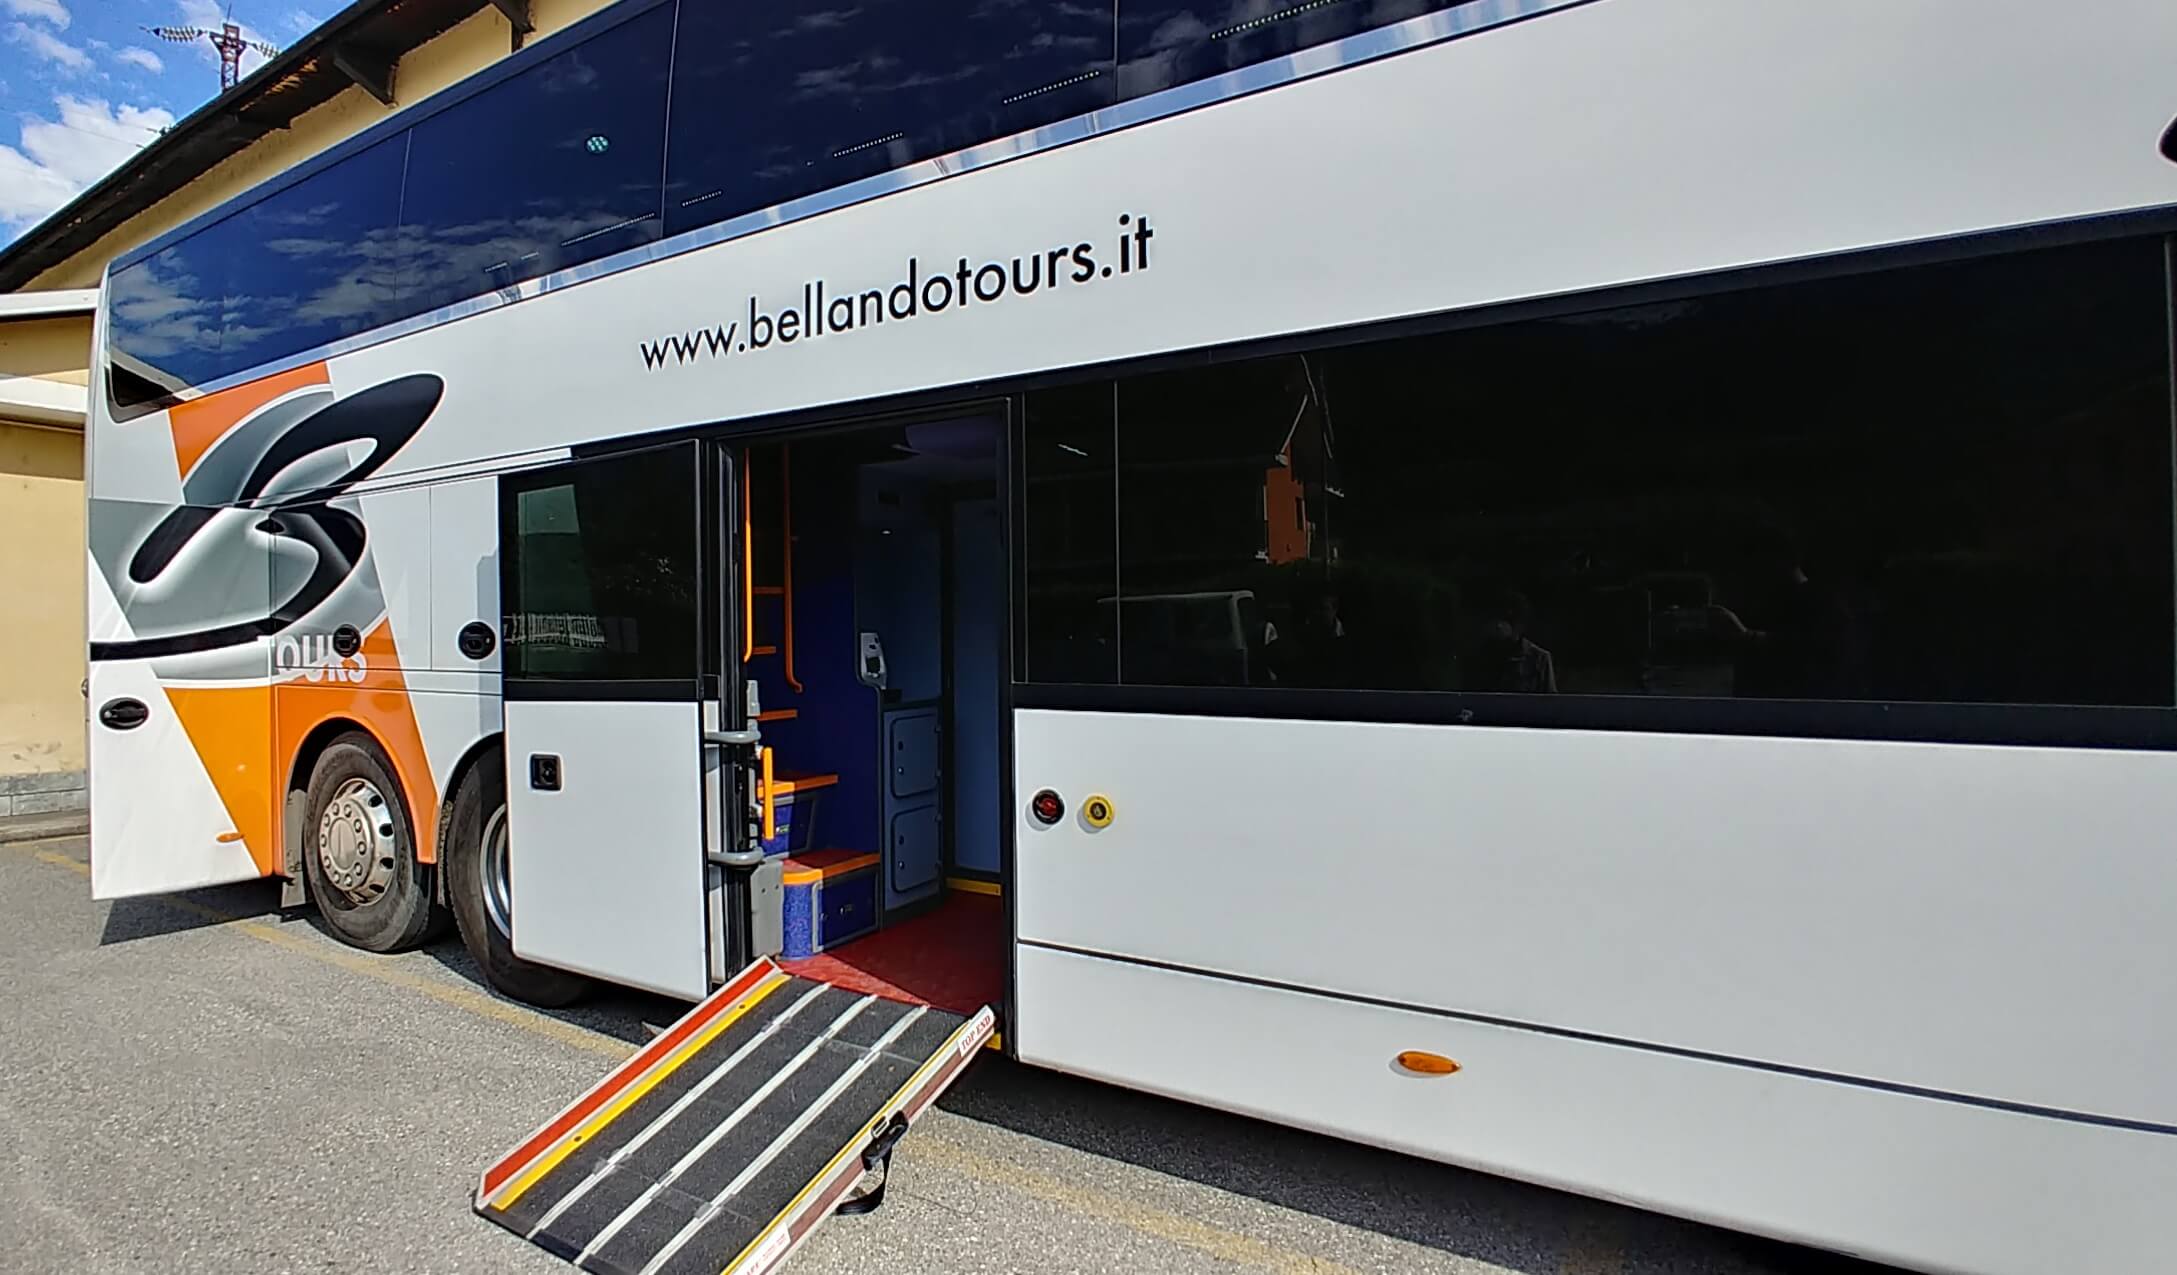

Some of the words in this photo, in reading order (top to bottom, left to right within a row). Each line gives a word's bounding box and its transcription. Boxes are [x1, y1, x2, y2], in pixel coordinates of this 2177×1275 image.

[640, 214, 1154, 370] www.bellandotours.it
[961, 1030, 976, 1051] TOP
[975, 1015, 991, 1033] END
